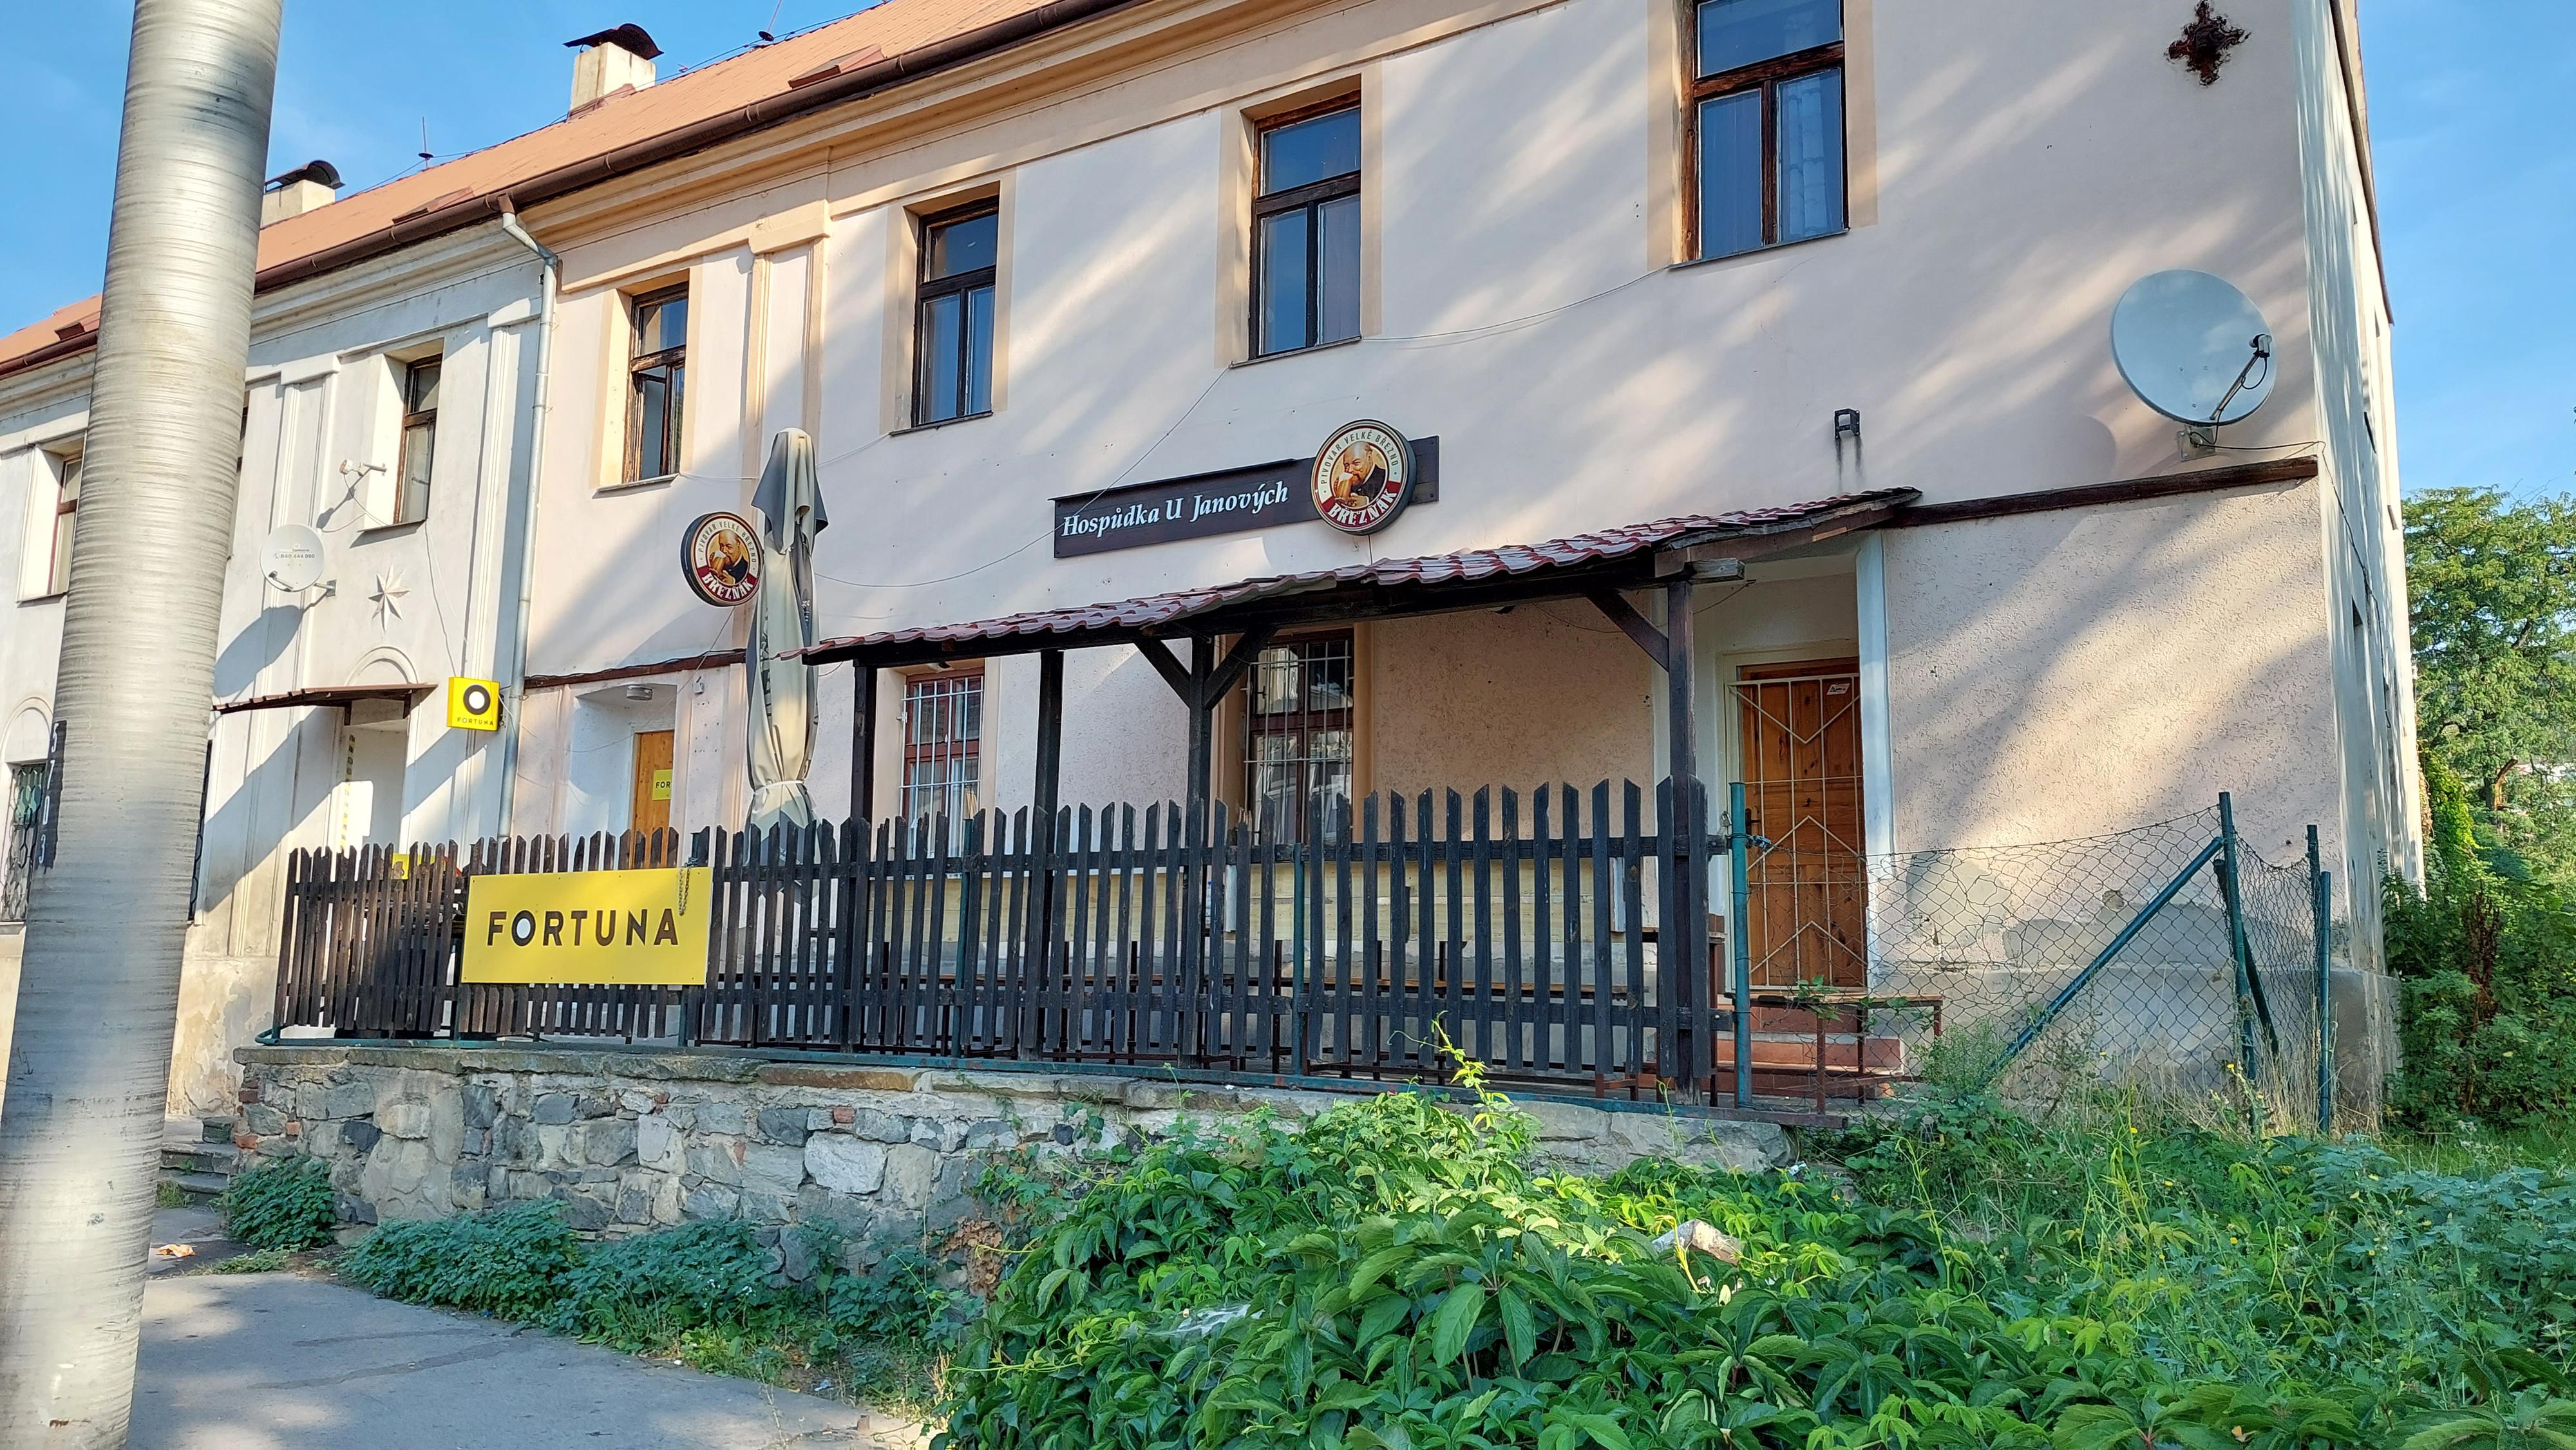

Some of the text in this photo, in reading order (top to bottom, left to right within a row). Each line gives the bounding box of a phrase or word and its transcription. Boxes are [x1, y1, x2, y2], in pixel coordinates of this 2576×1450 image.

[1320, 429, 1399, 484] PIVOVAR VELKÉ BŘEZNO
[1061, 480, 1289, 538] Hospůdka U Janových
[1327, 488, 1398, 525] BŘEZŇÁK
[698, 521, 757, 563] PIVOVAR VELKÉ BŘEZNO
[457, 717, 494, 726] FORTUNA
[487, 908, 679, 946] FORTUNA
